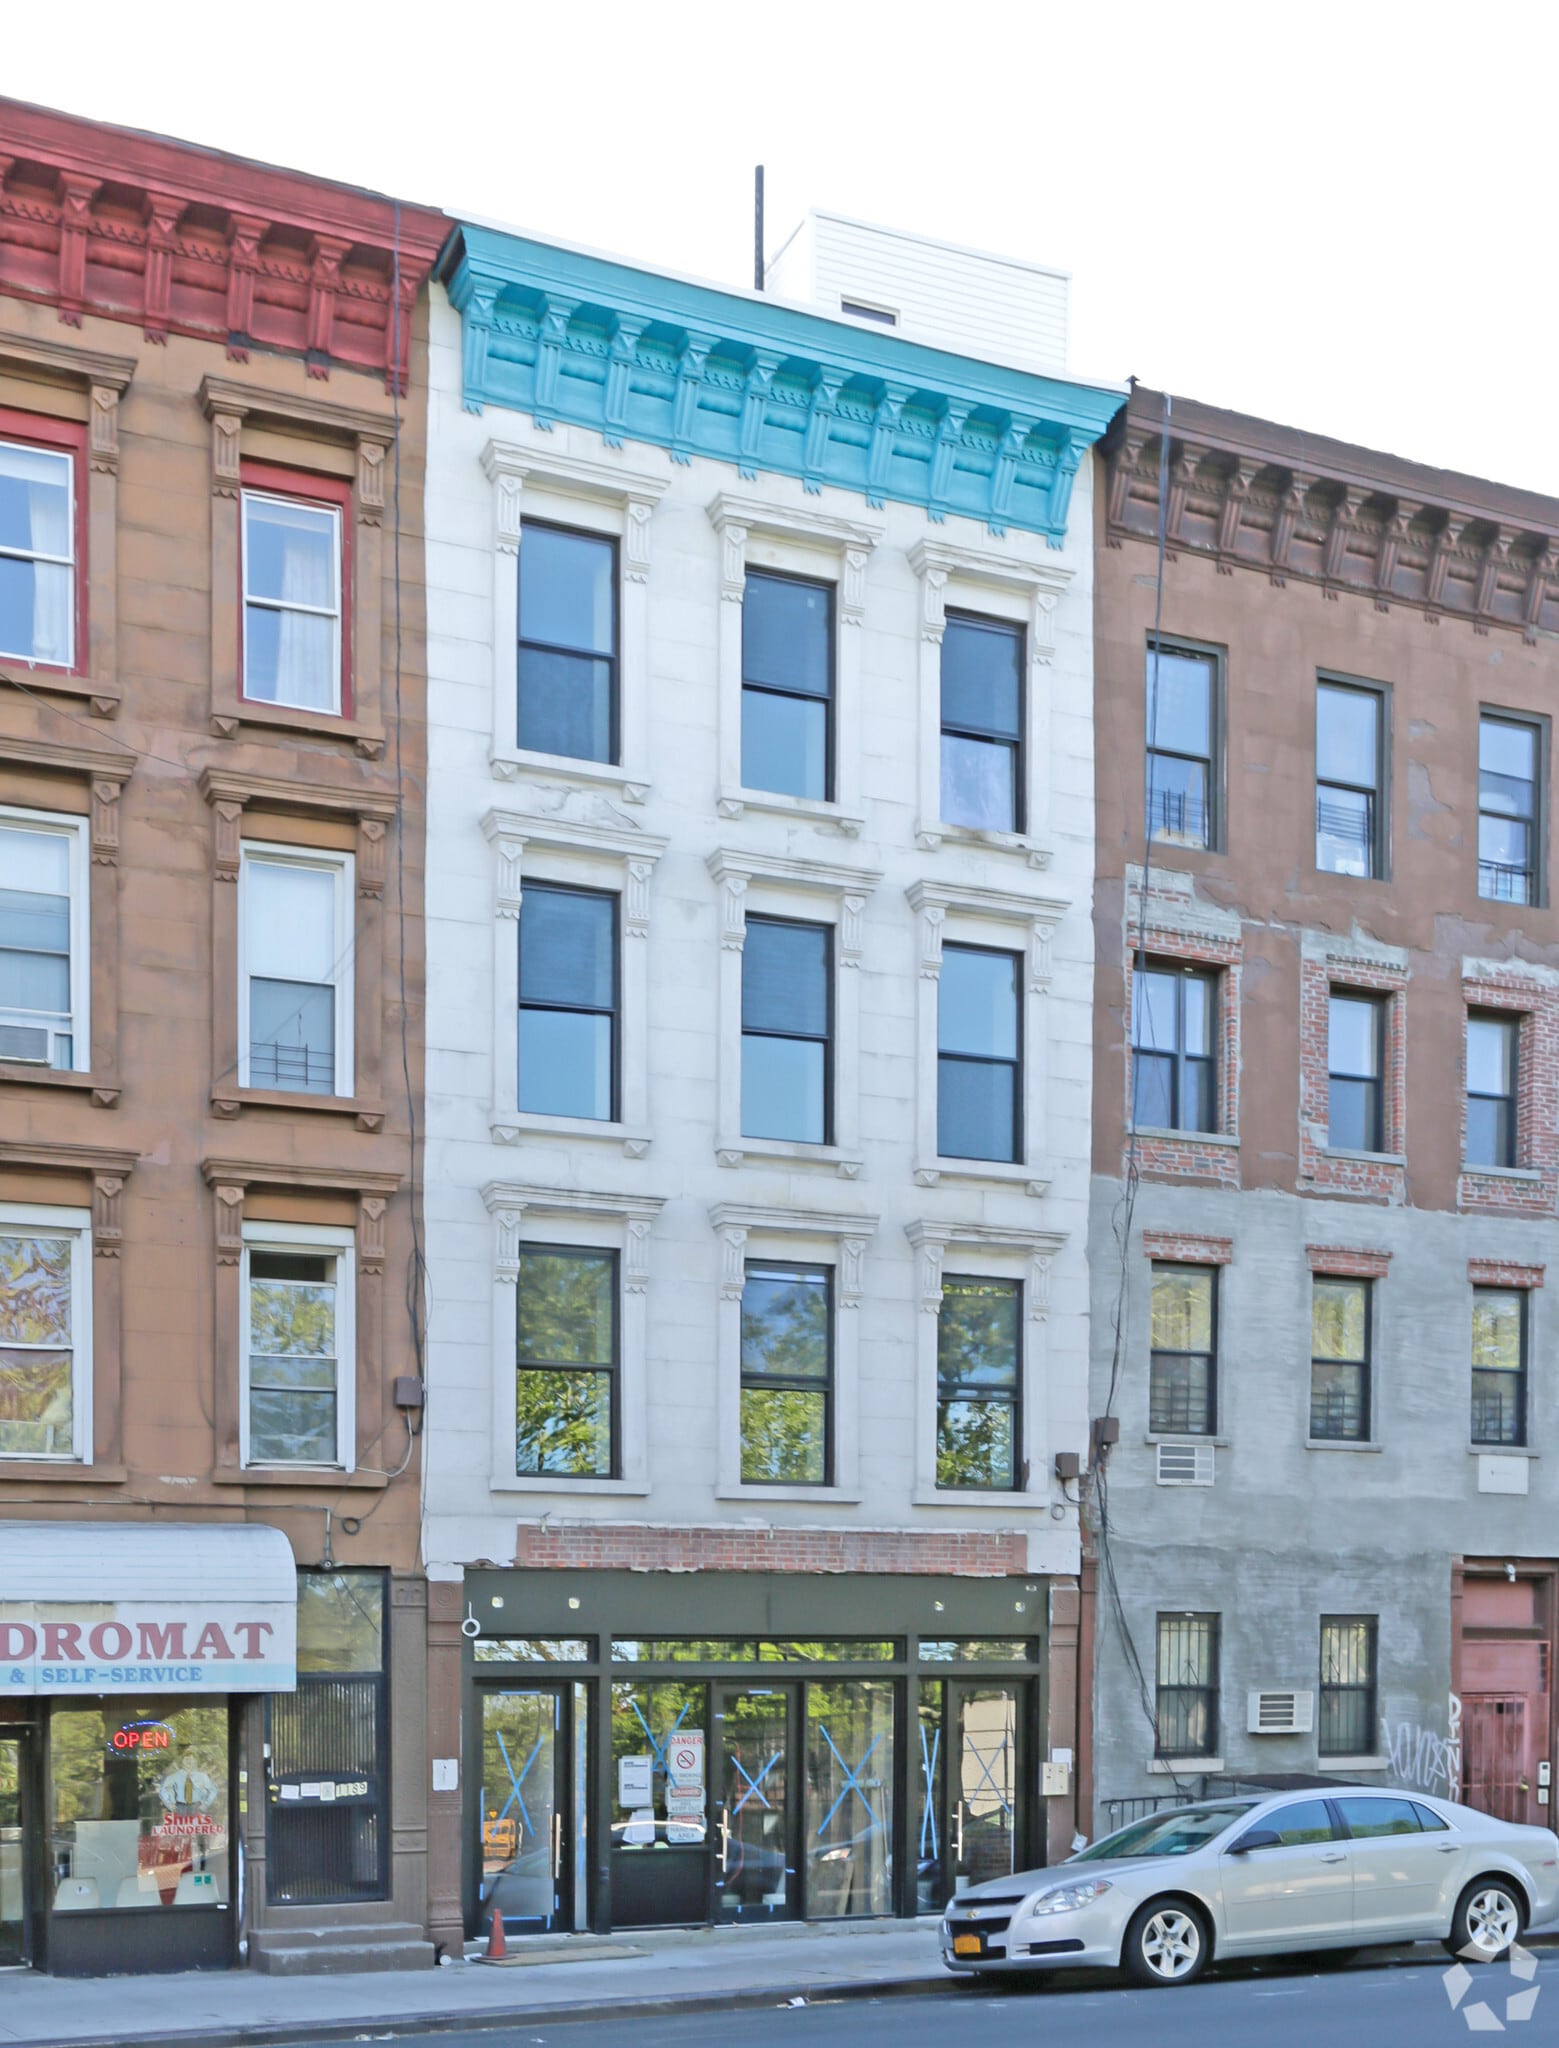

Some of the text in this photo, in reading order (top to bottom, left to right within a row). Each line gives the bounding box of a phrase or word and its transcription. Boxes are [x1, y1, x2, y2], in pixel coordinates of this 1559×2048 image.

[0, 1621, 274, 1661] DROMAT
[9, 1666, 202, 1684] & SELF-SERVICE
[113, 1731, 170, 1749] OPEN
[671, 1736, 703, 1745] DANGER
[339, 1783, 366, 1795] 1189
[163, 1812, 212, 1826] Shirts
[151, 1824, 225, 1836] LAUNDERED
